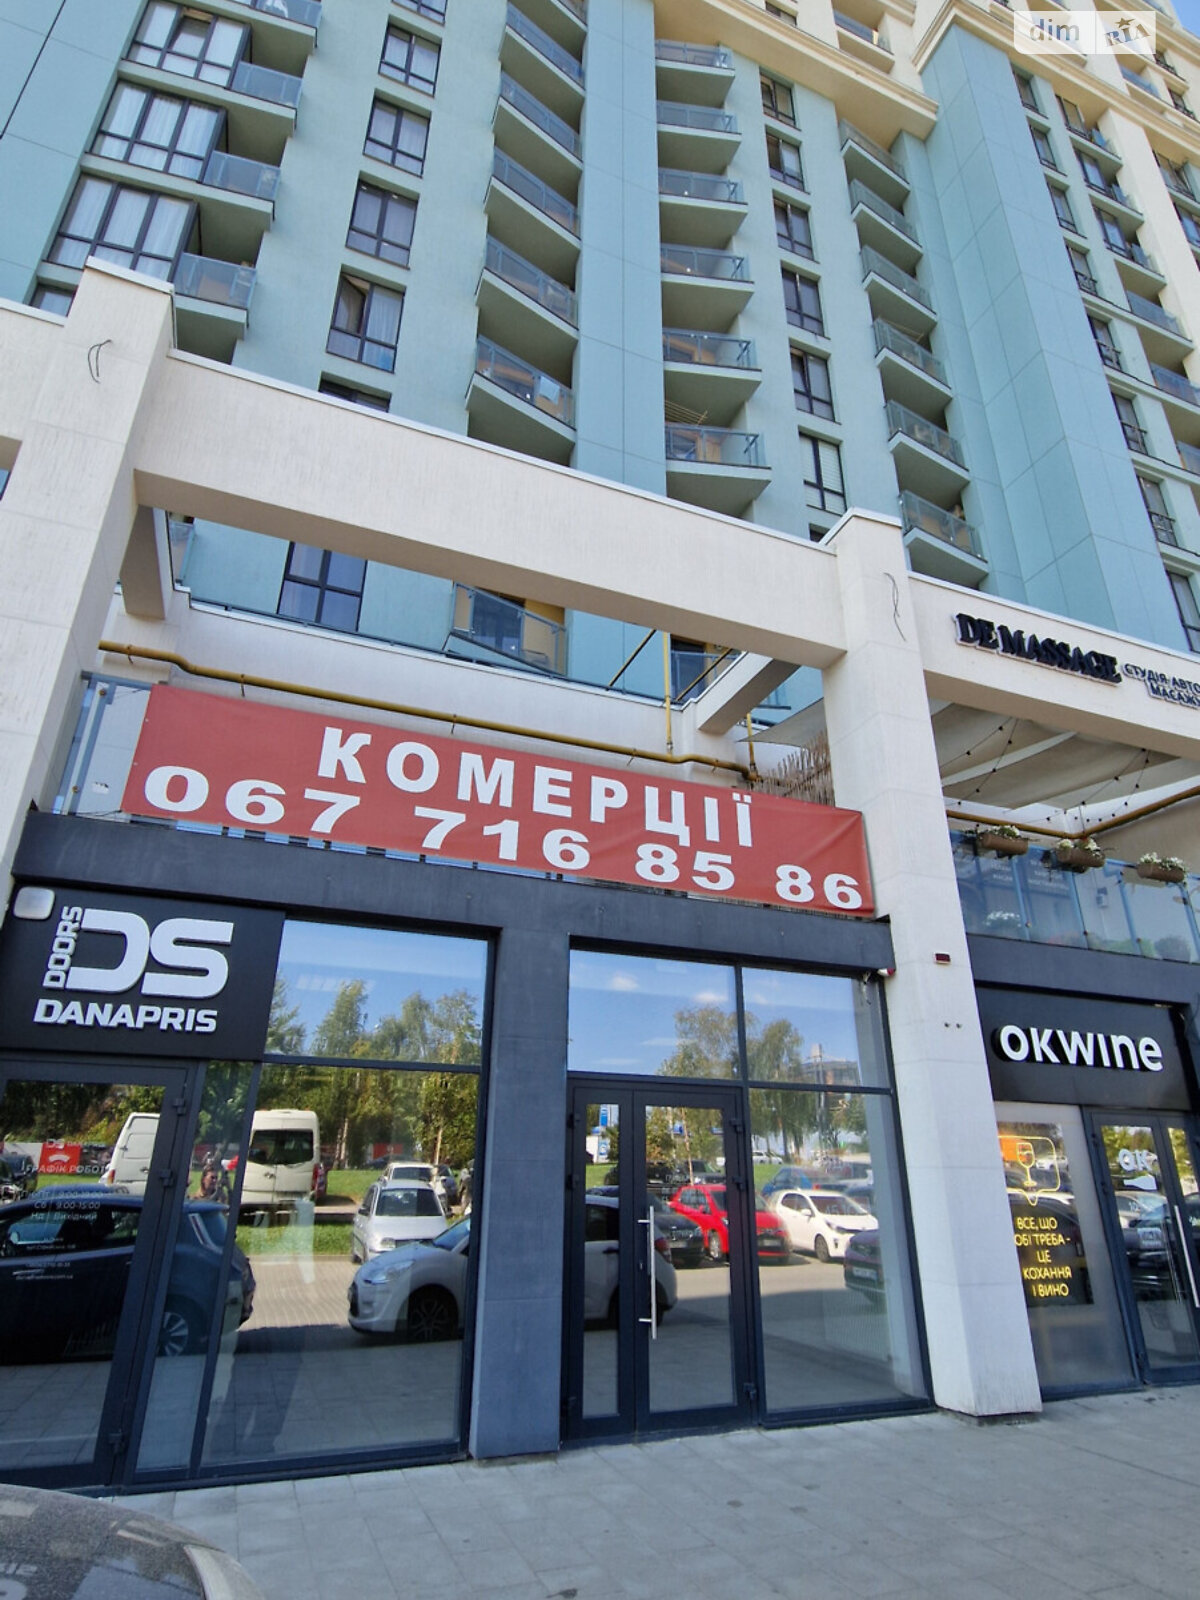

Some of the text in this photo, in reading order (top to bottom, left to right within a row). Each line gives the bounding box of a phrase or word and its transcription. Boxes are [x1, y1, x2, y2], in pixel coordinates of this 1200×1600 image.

[997, 624, 1123, 685] MASSAGE
[1124, 663, 1168, 684] СТУДІЯ
[317, 726, 753, 847] КОМЕРЦІЇ
[144, 765, 863, 911] 067 716 85 86
[42, 906, 83, 989] DOORS
[65, 908, 235, 999] DS
[33, 998, 218, 1034] DANAPRIS
[1039, 1216, 1058, 1231] ЩО
[1013, 1233, 1032, 1246] ОБІ
[1031, 1233, 1066, 1246] ТРЕБА
[1036, 1249, 1053, 1264] ЦЕ
[1023, 1266, 1073, 1279] КОХАННЯ
[1038, 1283, 1070, 1297] ВИНО
